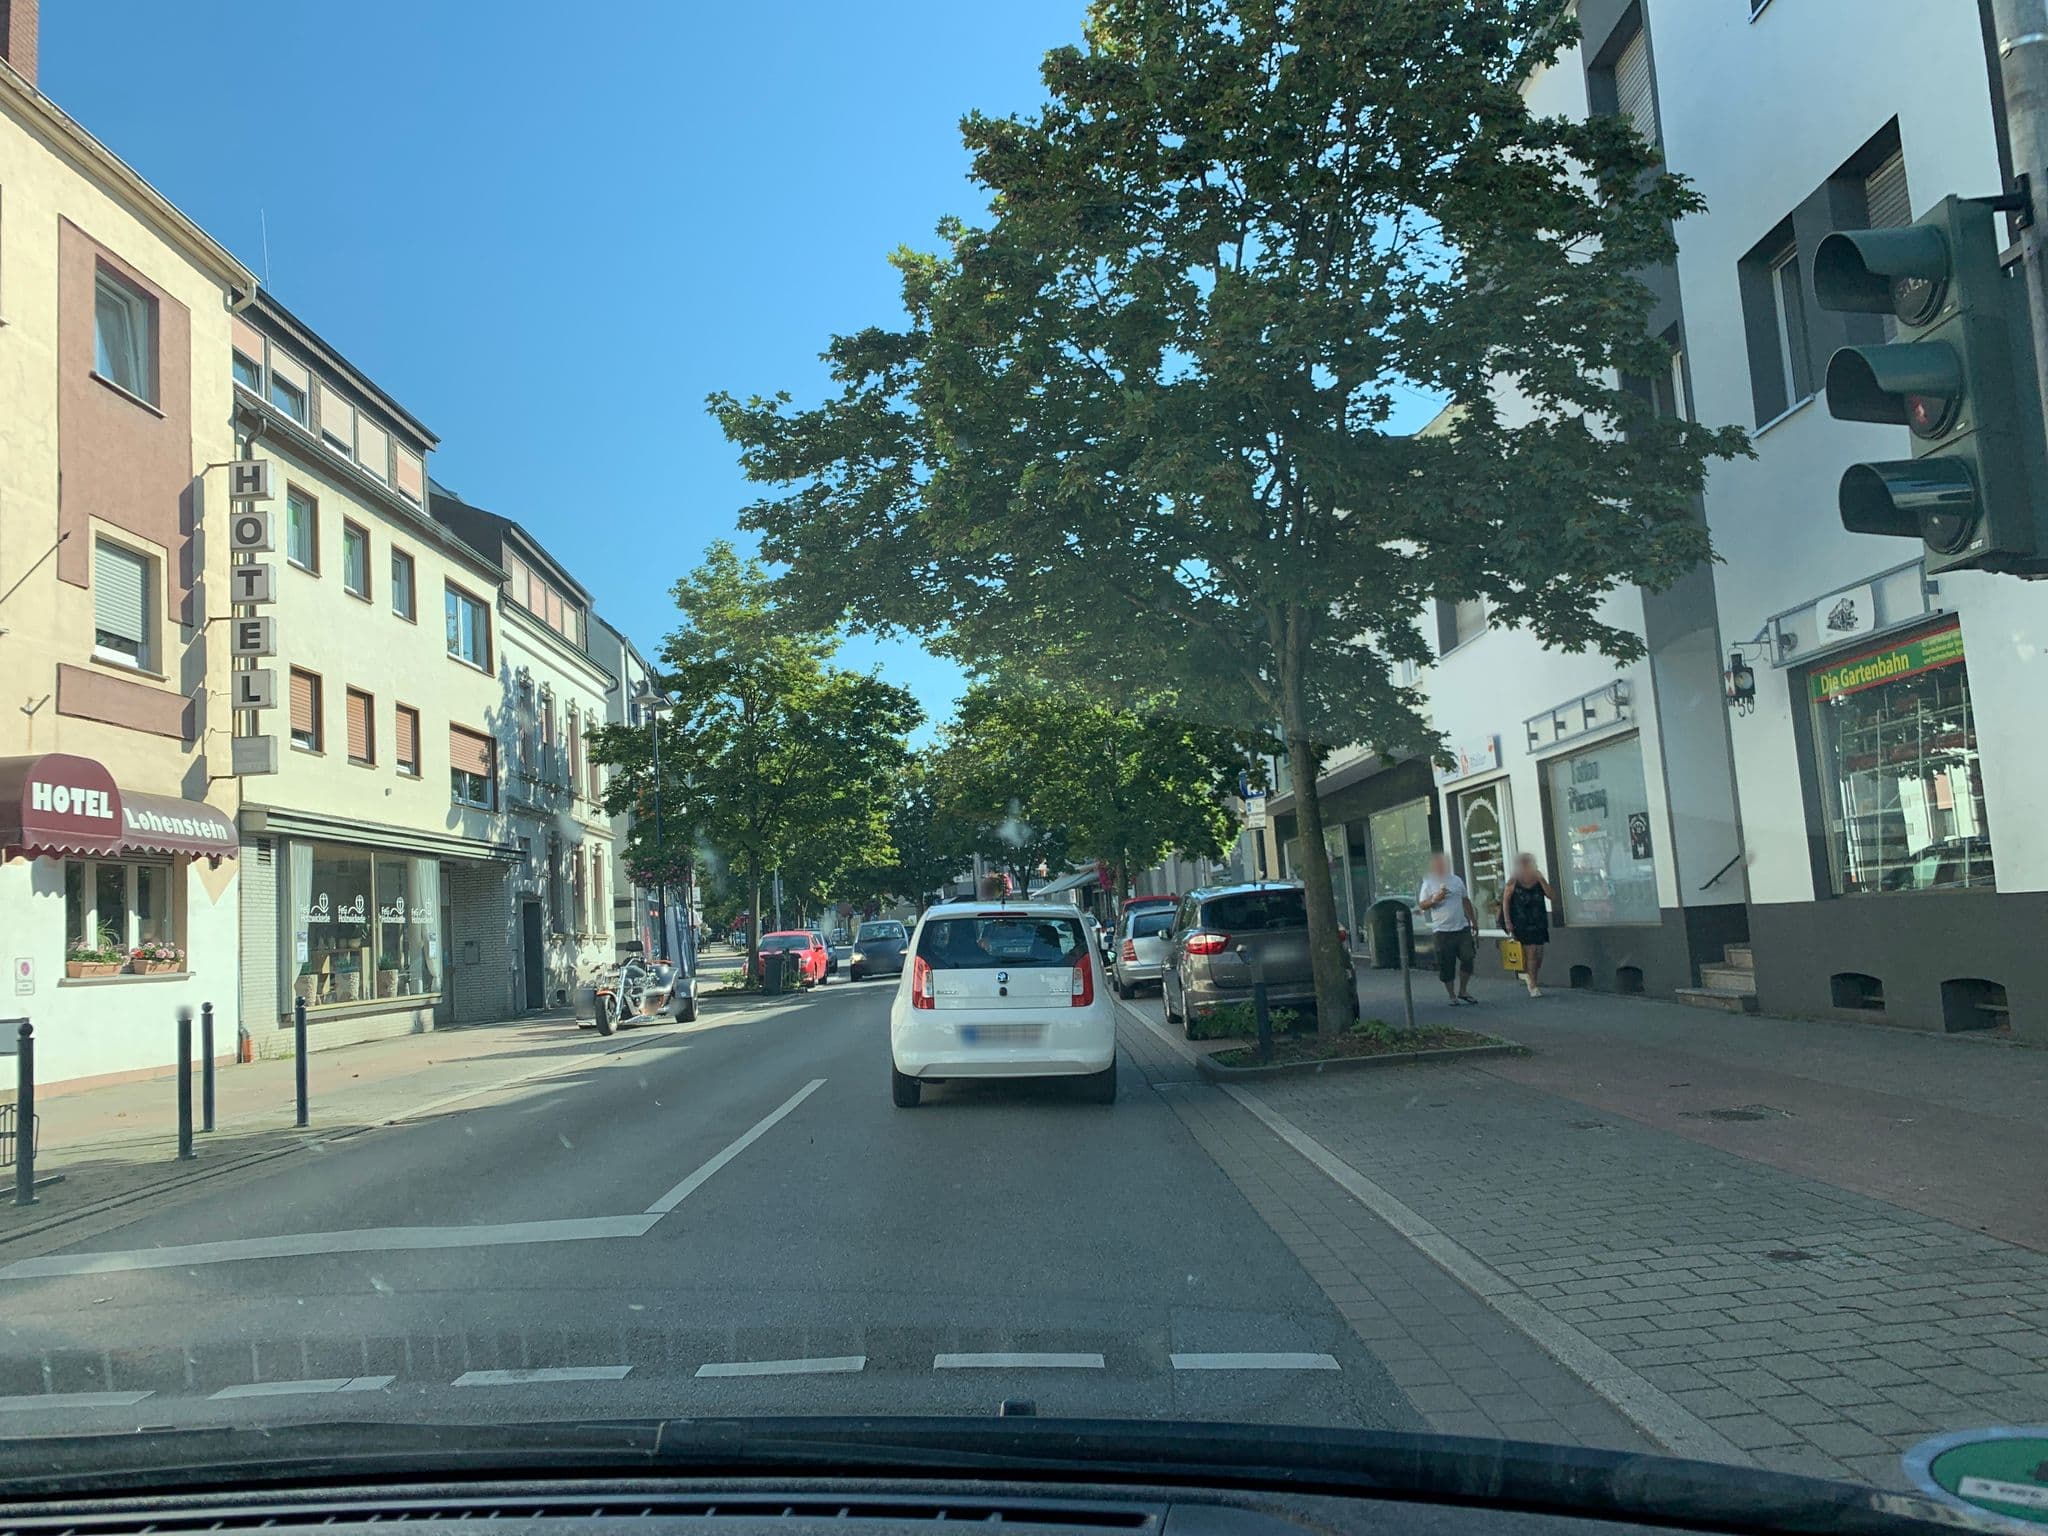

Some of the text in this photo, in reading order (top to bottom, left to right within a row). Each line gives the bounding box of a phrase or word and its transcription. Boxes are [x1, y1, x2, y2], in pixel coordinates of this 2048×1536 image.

[235, 465, 262, 703] HOTEL
[1820, 671, 1840, 694] Die
[1840, 651, 1910, 688] Gartenbahn
[32, 781, 228, 840] HOTEL Lohenstein
